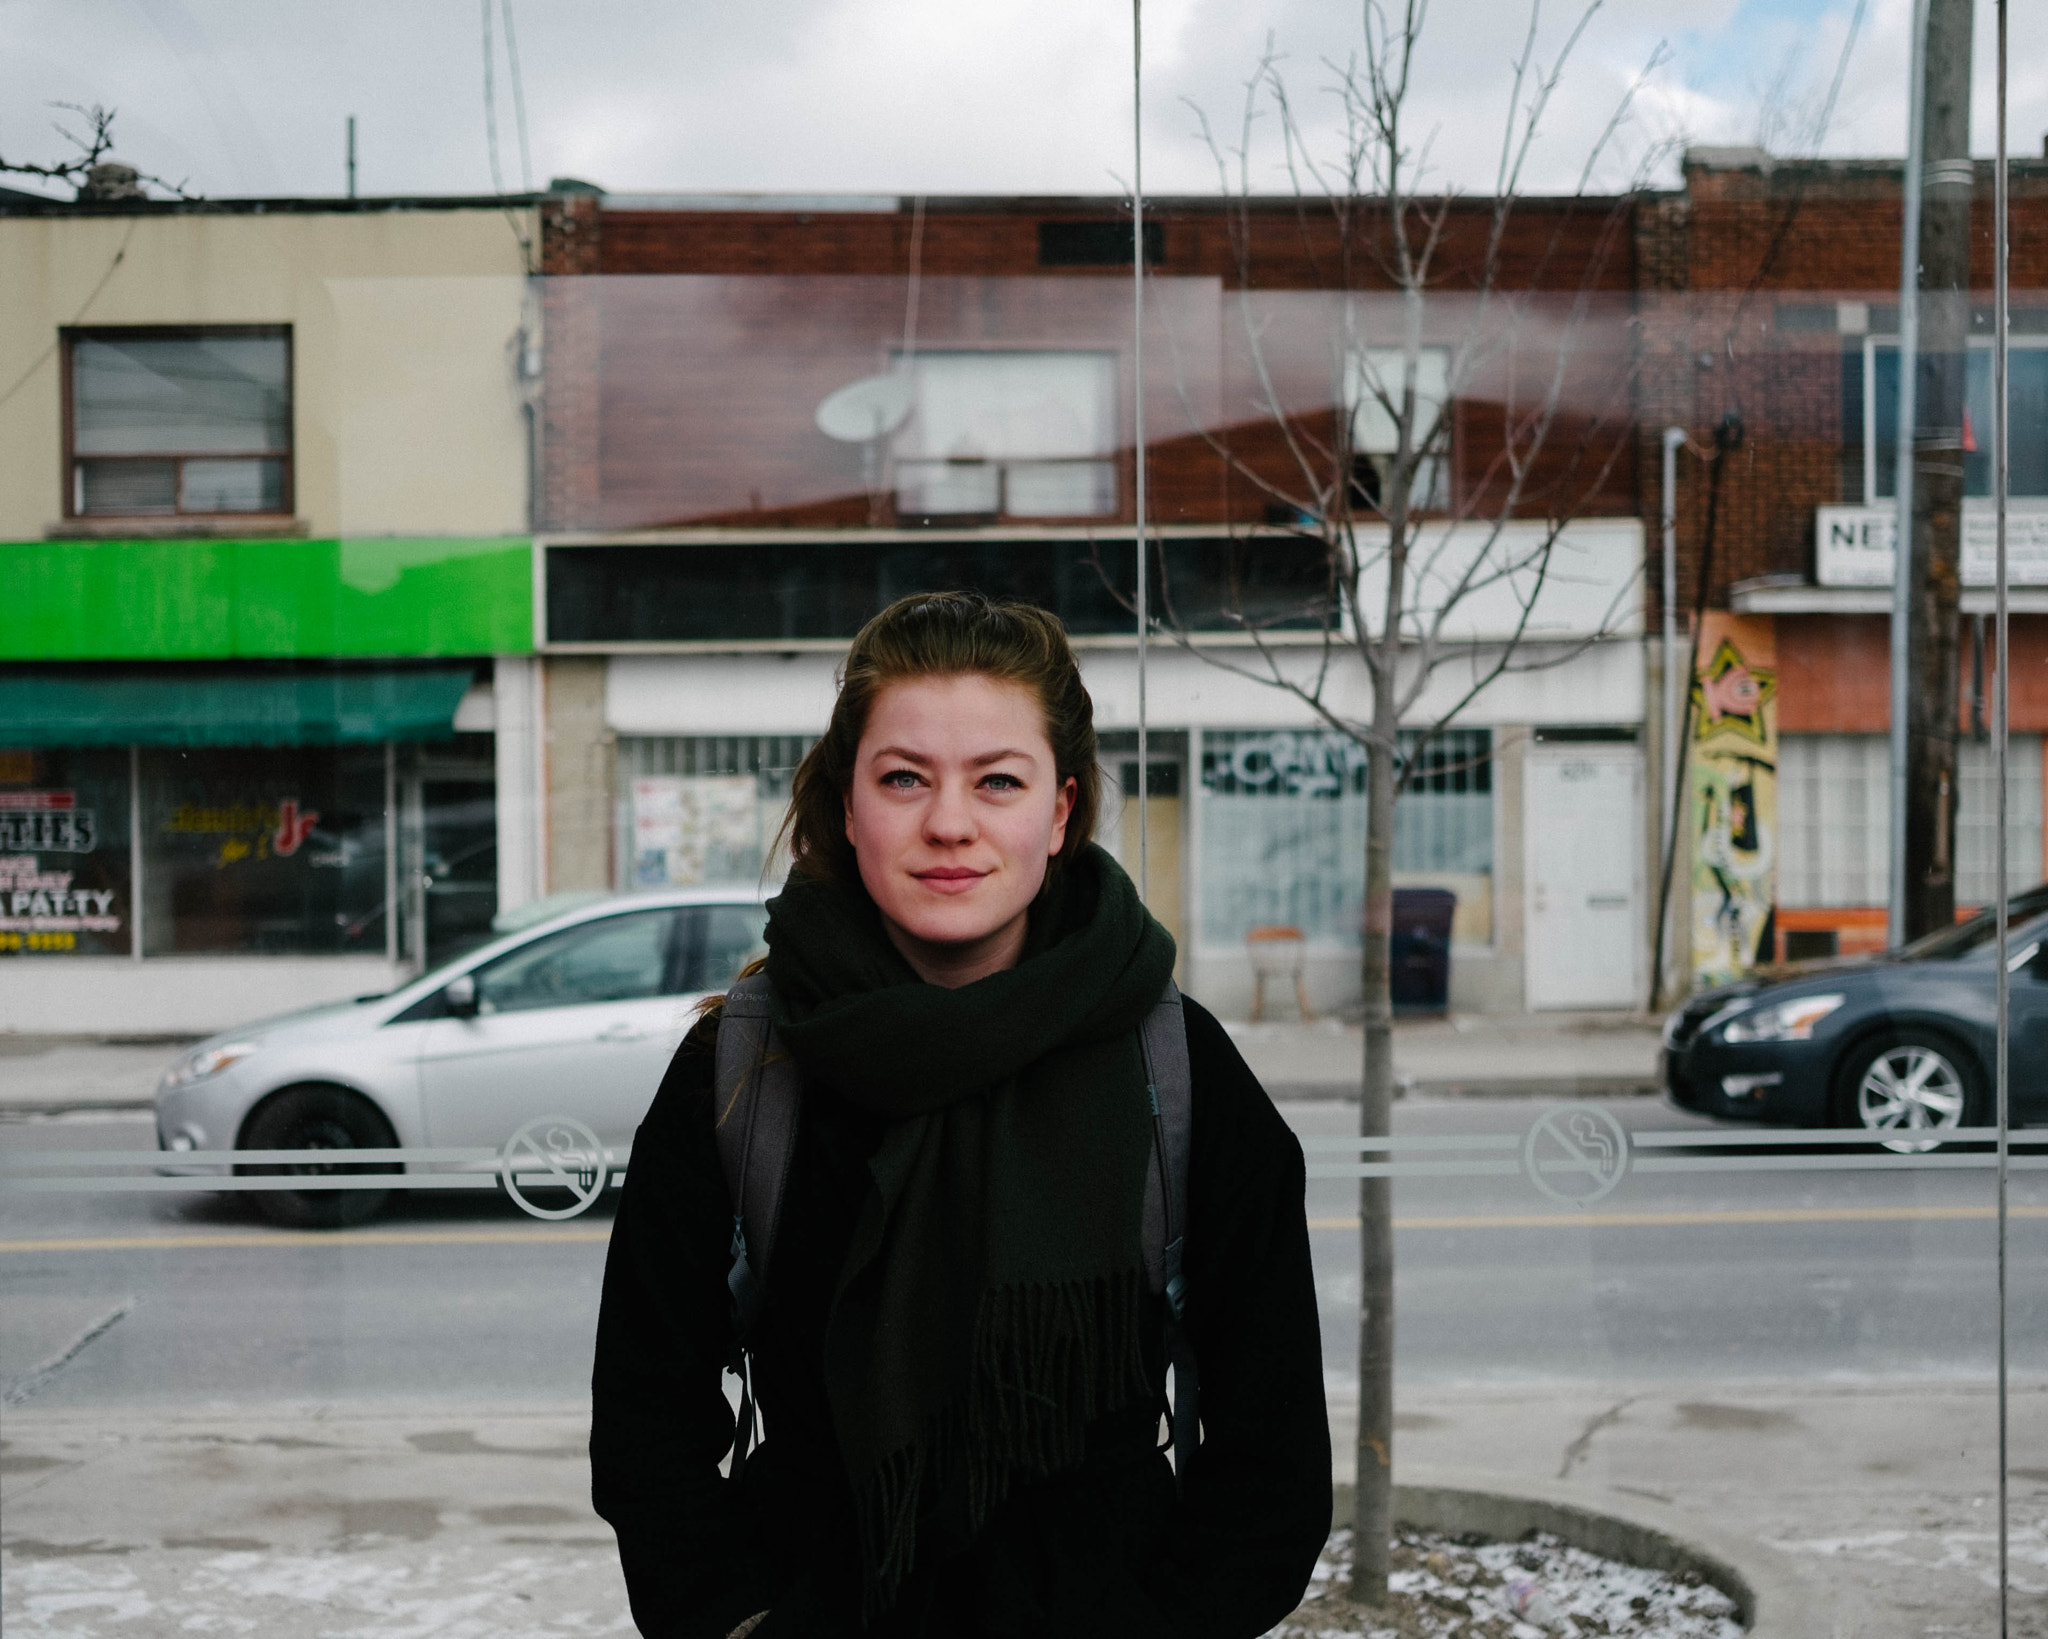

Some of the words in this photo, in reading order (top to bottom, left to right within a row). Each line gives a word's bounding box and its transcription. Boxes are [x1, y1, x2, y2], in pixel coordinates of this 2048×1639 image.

[1830, 521, 1898, 547] NE
[0, 811, 95, 850] TIES
[274, 800, 319, 856] Jr
